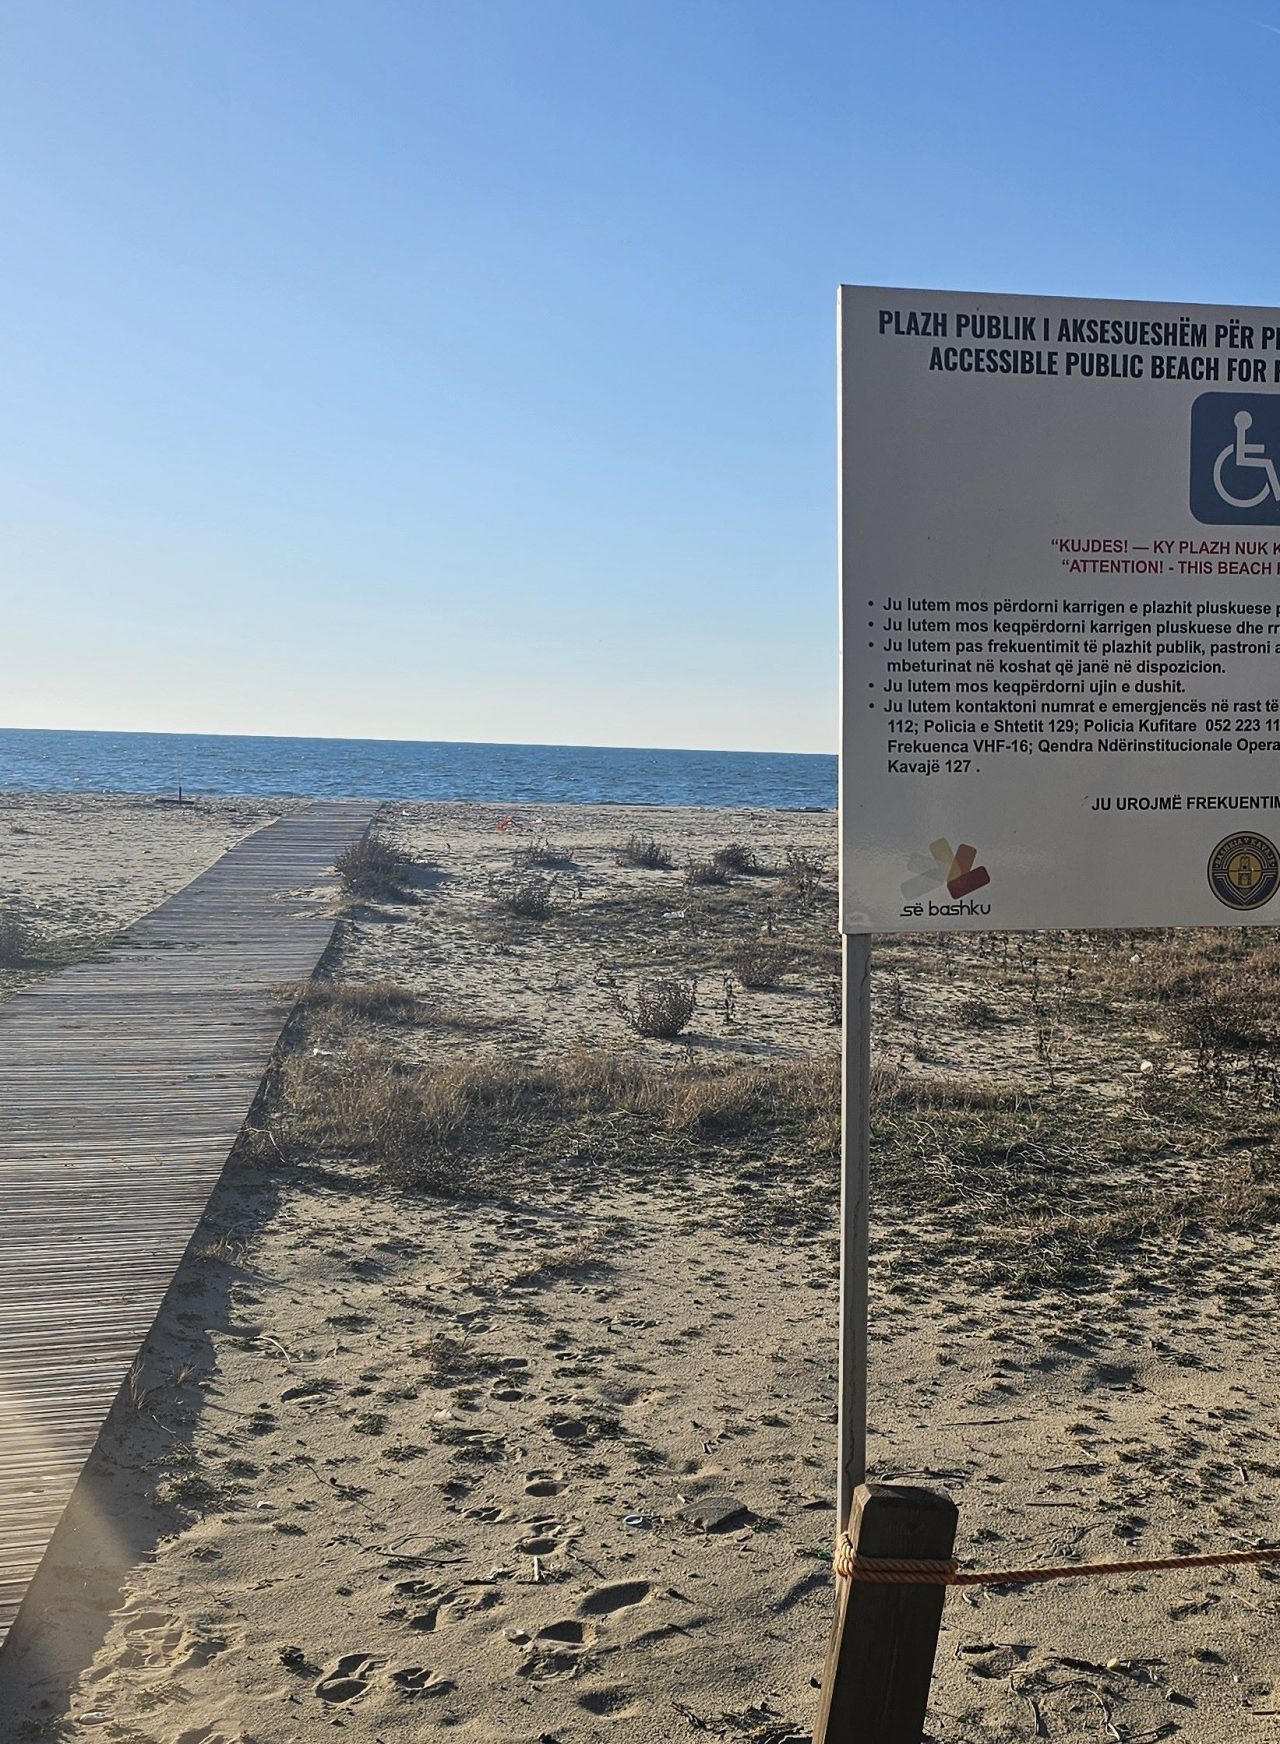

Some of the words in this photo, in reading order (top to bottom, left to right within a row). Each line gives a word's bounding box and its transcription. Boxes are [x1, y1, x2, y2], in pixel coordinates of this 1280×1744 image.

[878, 309, 947, 337] PLAZH
[955, 313, 1036, 341] PUBLIK
[1043, 317, 1049, 341] I
[1056, 316, 1207, 348] AKSESUESHËM
[1214, 319, 1254, 349] PËR
[928, 347, 1058, 376] ACCESSIBLE
[1065, 351, 1143, 378] PUBLIC
[1150, 354, 1219, 381] BEACH
[1227, 357, 1267, 382] FOR
[1153, 539, 1175, 554] KY
[1178, 540, 1230, 555] PLAZH
[1235, 541, 1268, 555] NUK
[1177, 560, 1213, 574] THIS
[1217, 560, 1272, 575] BEACH
[882, 596, 902, 611] Ju
[907, 597, 950, 611] lutem
[955, 600, 988, 612] mos
[993, 598, 1058, 615] përdorni
[1062, 599, 1125, 616] karrigen
[1129, 603, 1138, 614] e
[1142, 599, 1192, 617] plazhit
[1196, 600, 1271, 617] pluskuese
[882, 617, 902, 631] Ju
[907, 617, 950, 632] lutem
[955, 621, 988, 632] mos
[993, 618, 1085, 636] keqpërdorni
[1090, 619, 1151, 637] karrigen
[1156, 619, 1232, 637] pluskuese
[1235, 620, 1263, 634] dhe
[883, 637, 902, 651] Ju
[907, 637, 950, 652] lutem
[955, 641, 983, 656] pas
[987, 638, 1080, 653] frekuentimit
[1083, 638, 1097, 653] të
[1101, 639, 1152, 656] plazhit
[1155, 639, 1205, 657] publik,
[1210, 640, 1271, 657] pastroni
[887, 658, 972, 673] mbeturinat
[975, 658, 995, 673] në
[999, 658, 1051, 673] koshat
[1054, 658, 1073, 676] që
[1076, 658, 1109, 676] janë
[1113, 659, 1132, 673] në
[1136, 659, 1226, 676] dispozicion.
[883, 678, 902, 692] Ju
[907, 678, 950, 693] lutem
[955, 682, 988, 693] mos
[993, 679, 1085, 696] keqpërdorni
[1089, 678, 1117, 696] ujin
[1121, 682, 1130, 693] e
[1134, 679, 1185, 693] dushit.
[883, 698, 902, 713] Ju
[907, 699, 950, 713] lutem
[955, 698, 1036, 713] kontaktoni
[1041, 699, 1095, 713] numrat
[1098, 702, 1108, 712] e
[1111, 698, 1207, 716] emergjencës
[1210, 698, 1229, 712] në
[1233, 699, 1262, 712] rast
[1264, 698, 1279, 712] të
[887, 719, 918, 735] 112;
[923, 719, 976, 733] Policia
[980, 722, 989, 733] e
[993, 718, 1044, 733] Shtetit
[1047, 718, 1078, 735] 129;
[1083, 718, 1134, 732] Policia
[1138, 718, 1197, 732] Kufitare
[1205, 718, 1231, 732] 052
[1234, 718, 1261, 732] 223
[887, 739, 969, 753] Frekuenca
[972, 738, 1033, 755] VHF-16;
[1037, 738, 1093, 753] Qendra
[1097, 737, 1232, 752] Ndërinstitucionale
[887, 759, 940, 776] Kavajë
[944, 759, 971, 773] 127
[1091, 797, 1111, 811] JU
[1116, 793, 1182, 811] UROJMË
[899, 902, 924, 917] së
[928, 899, 991, 916] bashku
